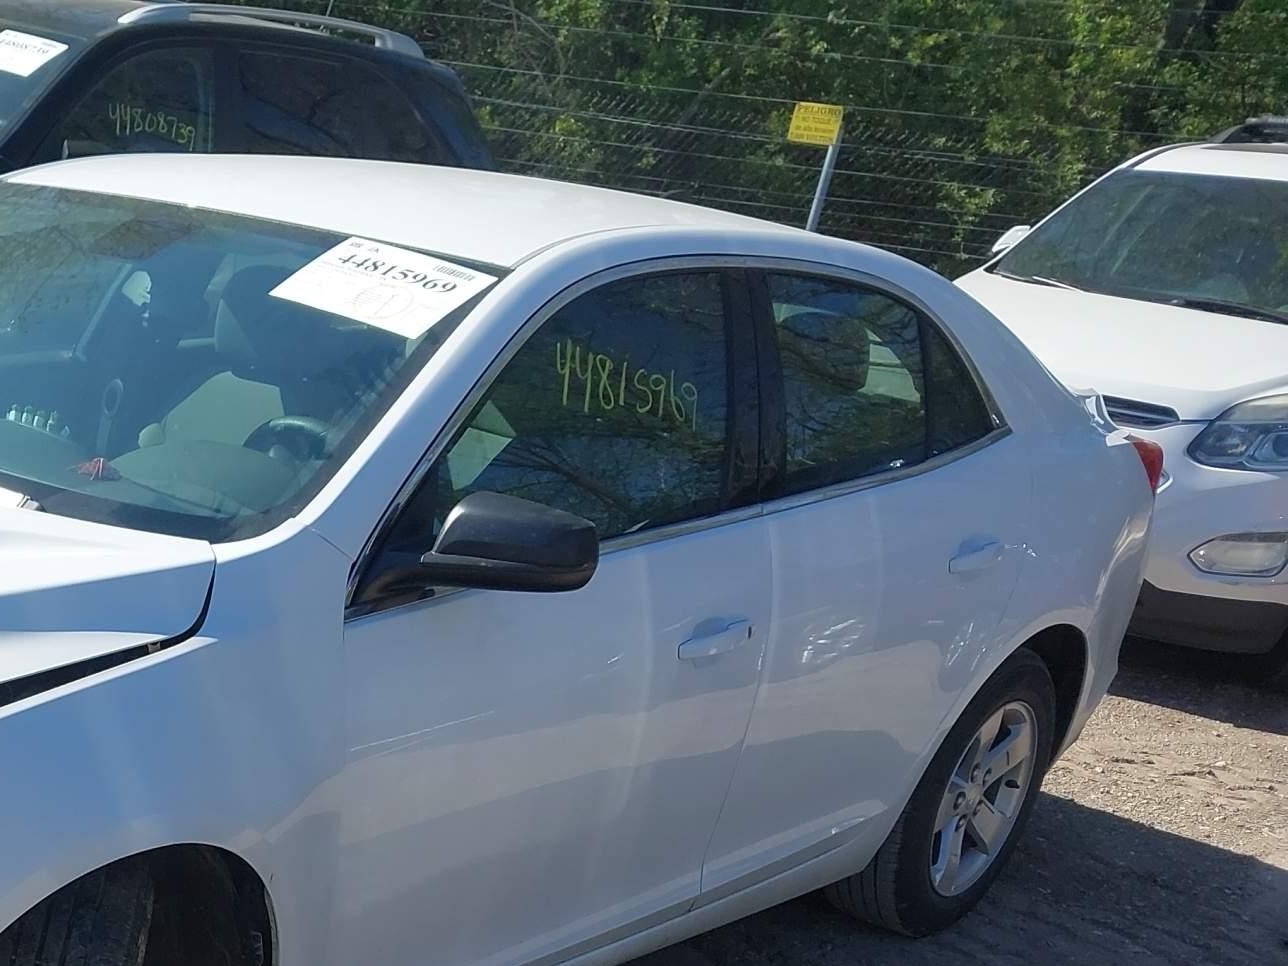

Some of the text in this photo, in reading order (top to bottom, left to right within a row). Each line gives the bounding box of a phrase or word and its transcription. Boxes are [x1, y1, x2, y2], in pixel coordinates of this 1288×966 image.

[108, 103, 196, 152] 44808739
[337, 254, 458, 293] 44815969
[556, 338, 698, 432] 44815969
